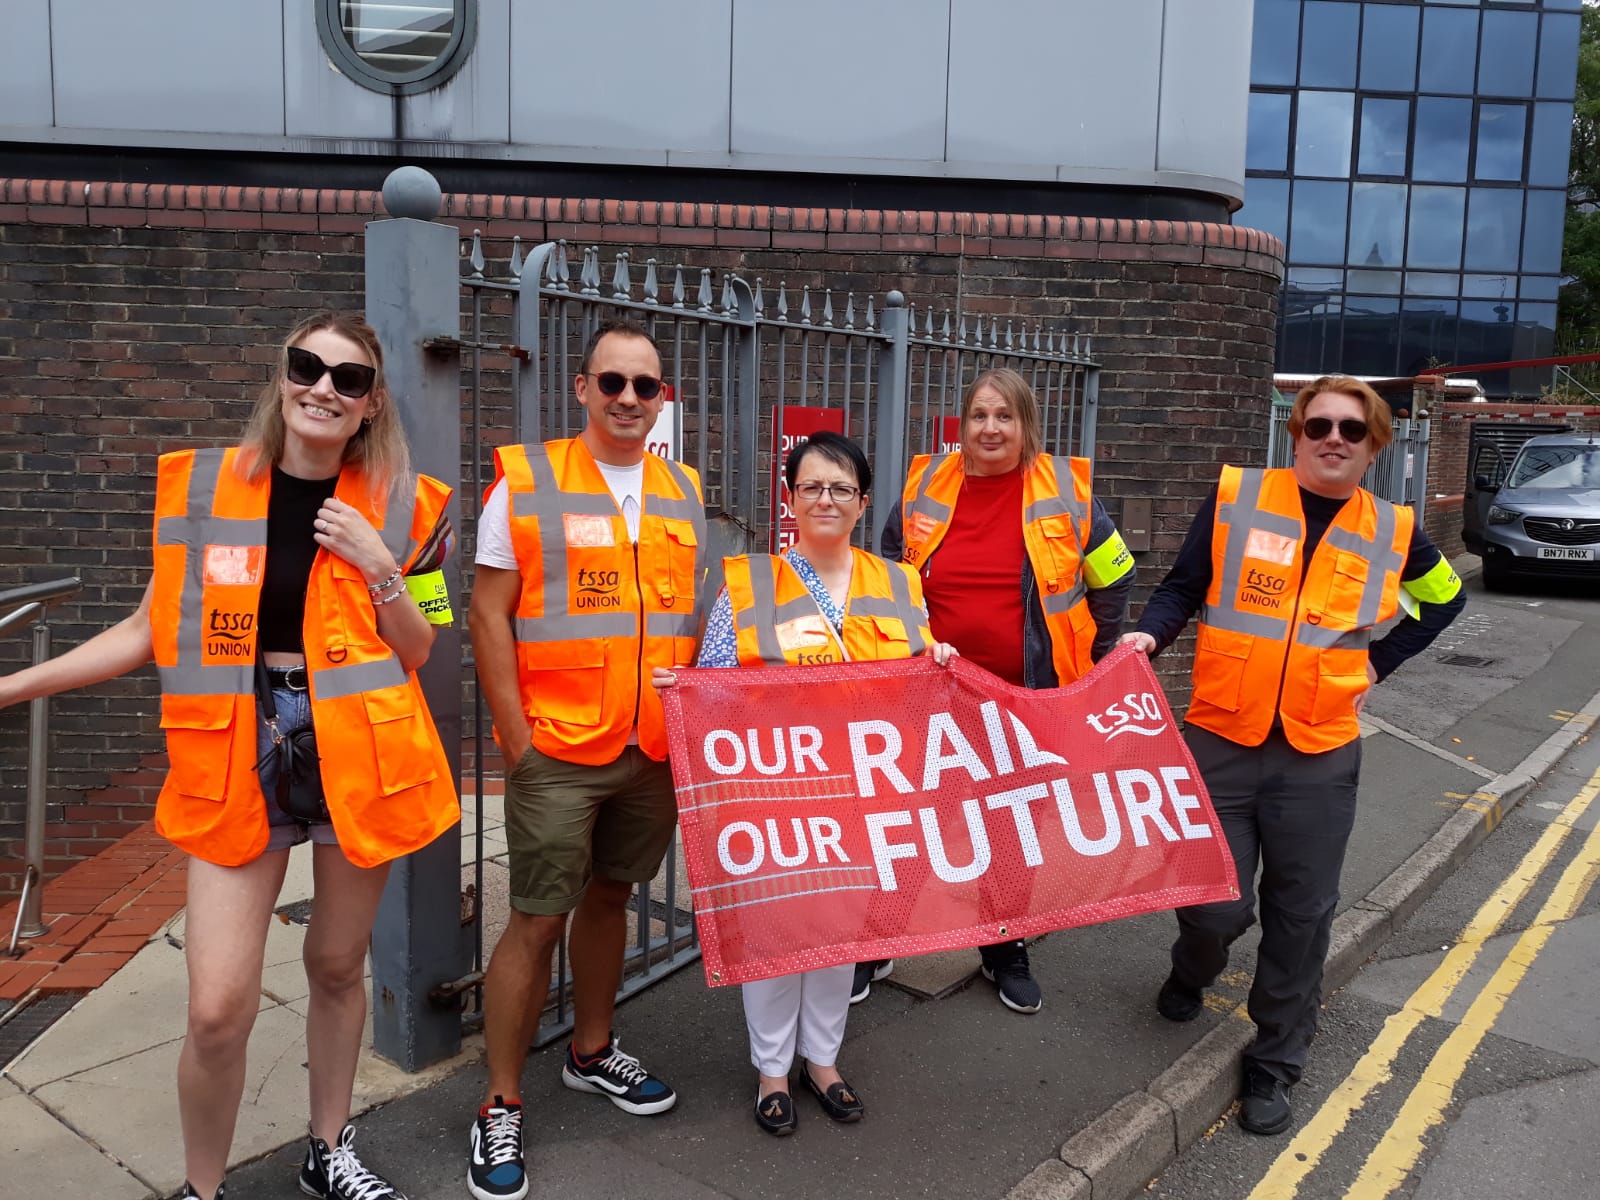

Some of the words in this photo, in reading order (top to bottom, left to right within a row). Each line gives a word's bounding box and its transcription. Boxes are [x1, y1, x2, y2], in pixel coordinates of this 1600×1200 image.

[1543, 548, 1566, 558] BN71
[1568, 549, 1588, 559] RNX
[578, 568, 619, 587] tssa
[1246, 568, 1286, 591] tssa
[576, 595, 620, 608] UNION
[1240, 591, 1280, 609] UNION
[210, 608, 254, 631] tssa
[208, 642, 251, 657] UNION
[1086, 692, 1163, 734] tssa
[703, 725, 830, 776] OUR
[847, 700, 1070, 798] RAIL
[717, 816, 851, 876] OUR
[864, 766, 1213, 892] FUTURE
